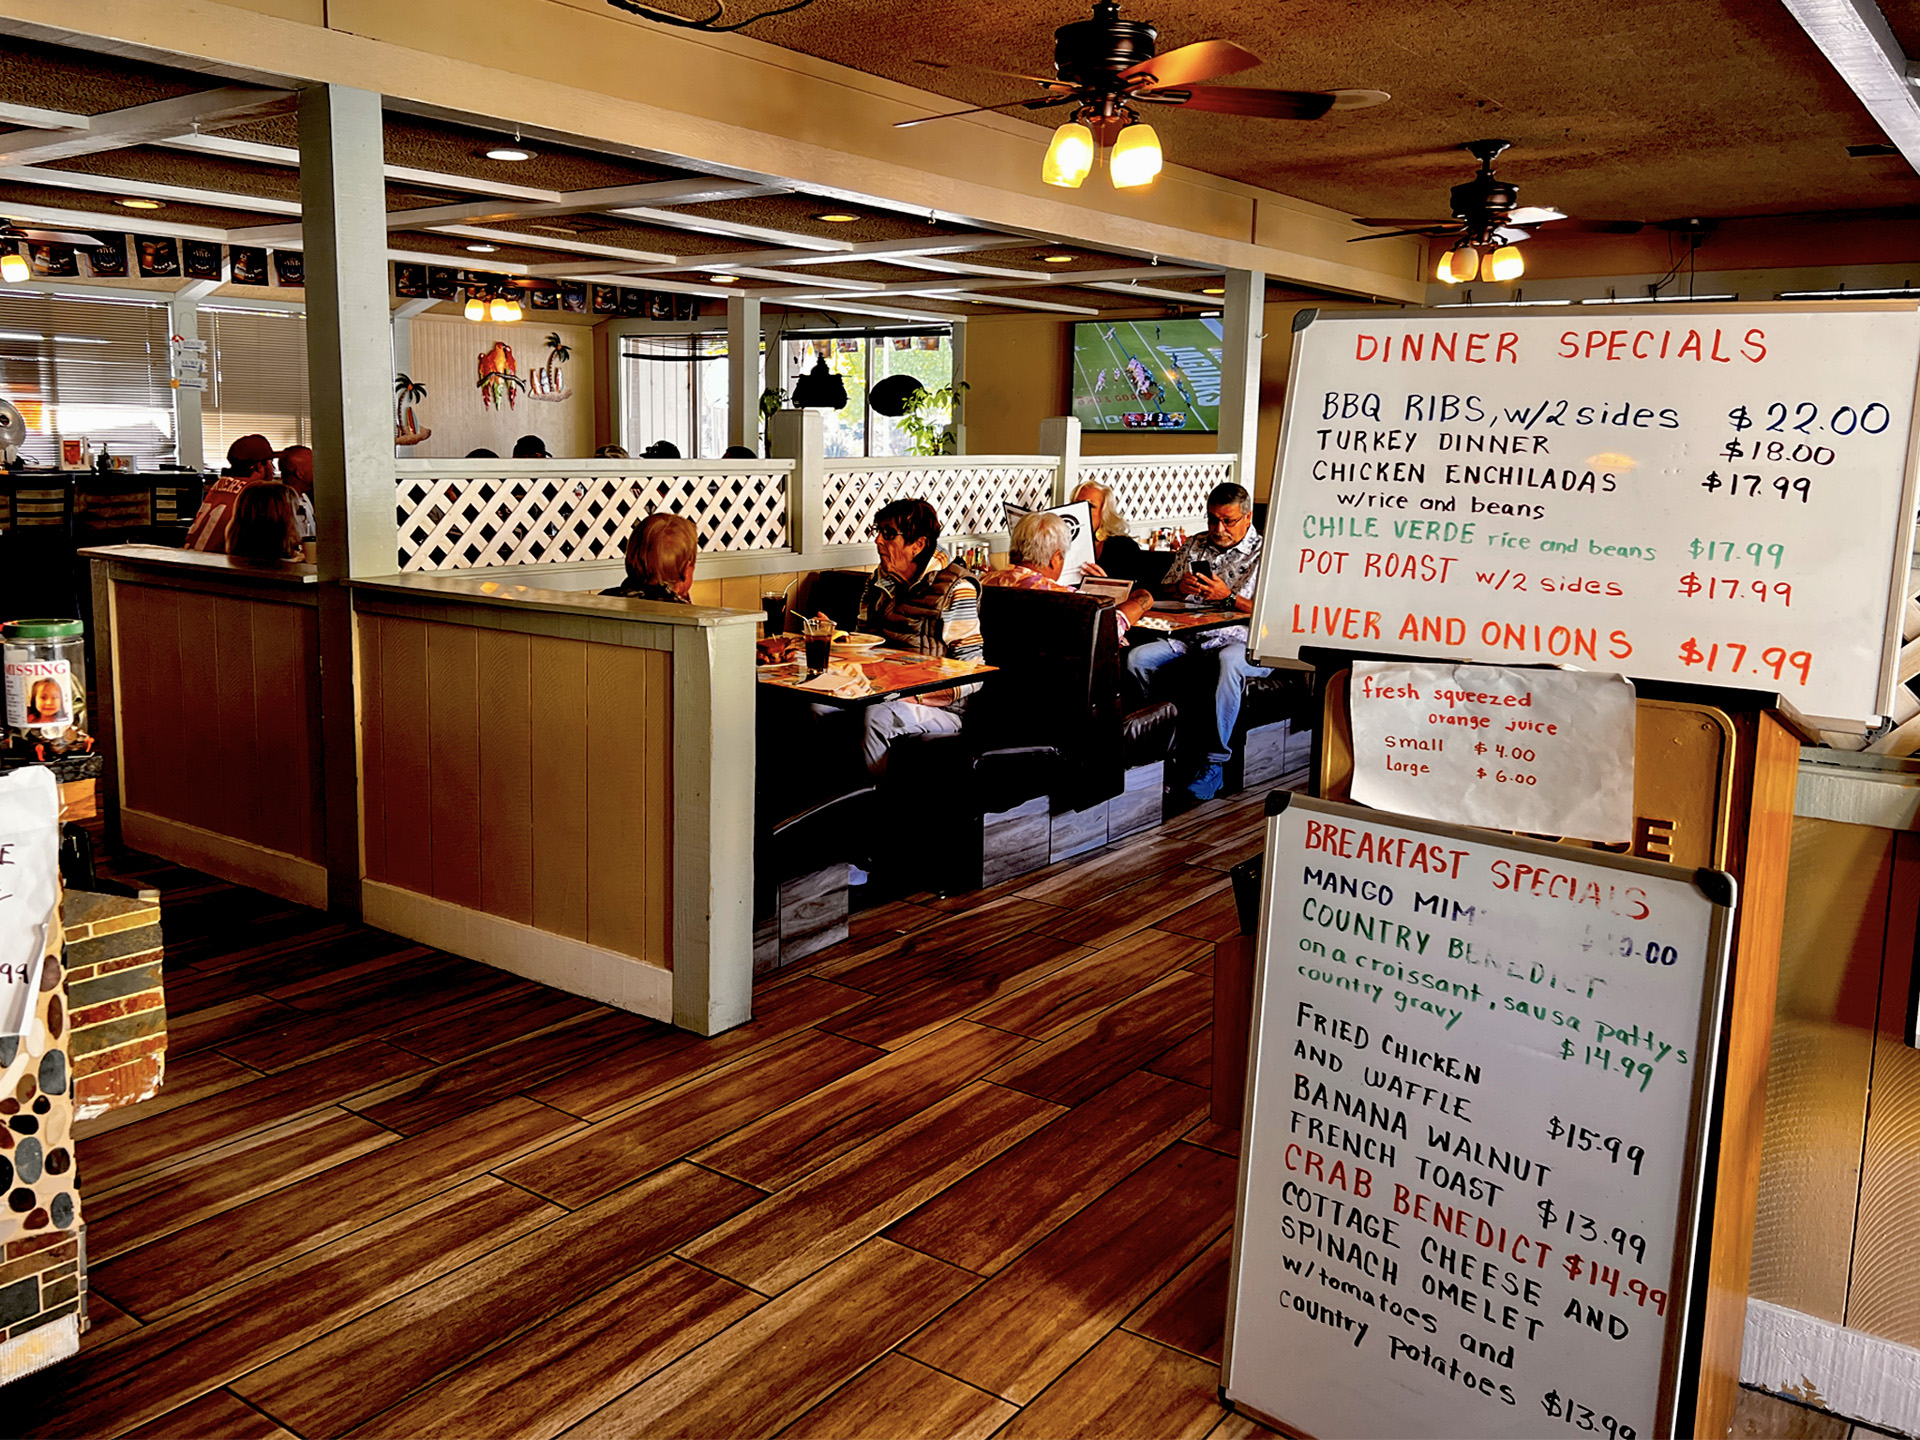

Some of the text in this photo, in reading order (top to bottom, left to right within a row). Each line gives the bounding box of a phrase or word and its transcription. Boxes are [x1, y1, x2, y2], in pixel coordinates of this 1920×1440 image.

[1355, 329, 1767, 364] DINNER SPECIALS
[1322, 392, 1381, 422] BBQ
[1504, 400, 1569, 430] w/2
[1576, 402, 1680, 429] sides
[1728, 402, 1890, 435] $22.00
[1316, 429, 1835, 466] TURKEY DINNER $18.00
[1313, 460, 1811, 503] CHICKEN ENCHILADAS $17.99
[1337, 492, 1545, 519] w/rice and beans
[1303, 515, 1784, 569] CHILE VERDE rice and beans $17.99
[1299, 548, 1792, 607] POT ROAST w/2 sides $17.99
[1292, 603, 1812, 686] LIVER AND ONIONS $17.99
[1362, 676, 1532, 708] fresh squeezed
[1428, 713, 1558, 736] orange juice
[1305, 820, 1471, 879] BREAKFAST
[1303, 866, 1394, 906] MANGO
[1303, 897, 1430, 956] COUNTRY
[1297, 1002, 1481, 1084] FRIED CHICKEN
[1298, 965, 1654, 1093] country gravy $14.99
[1294, 1039, 1645, 1175] AND WAFFLE $15.99
[1294, 1073, 1552, 1187] BANANA WALNUT
[1290, 1110, 1646, 1264] FRENCH TOAST $13.99
[1285, 1143, 1667, 1317] CRAB BENEDICT $14.99
[1281, 1215, 1544, 1341] SPINACH OMELET
[1282, 1181, 1629, 1340] COTTAGE CHEESE AND
[1279, 1290, 1369, 1347] country
[1541, 1389, 1637, 1440] $13.99
[1460, 1333, 1514, 1369] and
